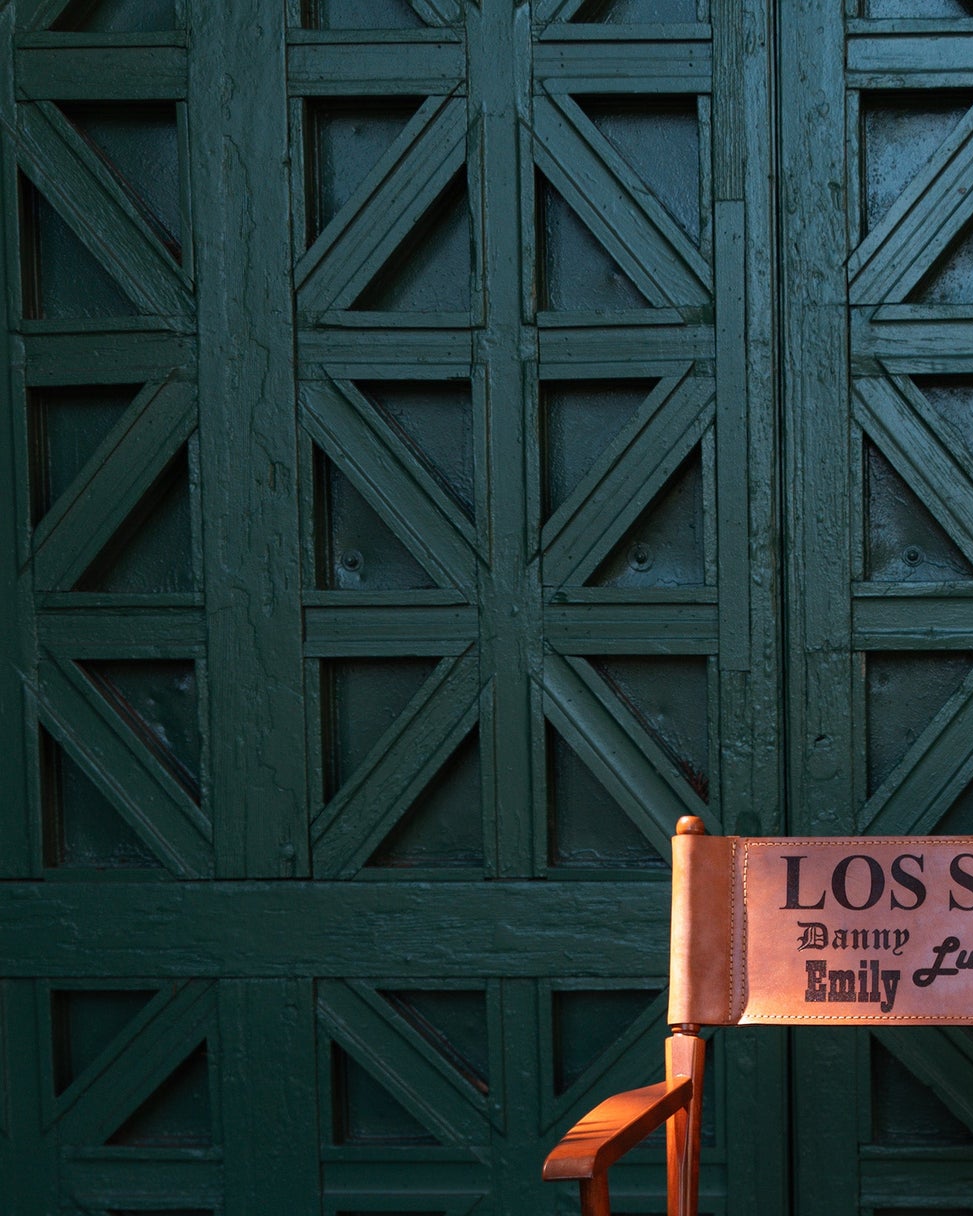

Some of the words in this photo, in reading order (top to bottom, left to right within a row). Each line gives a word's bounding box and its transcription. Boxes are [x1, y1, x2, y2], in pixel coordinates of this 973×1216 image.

[780, 853, 927, 911] LOS
[797, 921, 910, 955] Danny
[805, 960, 901, 1013] Emily
